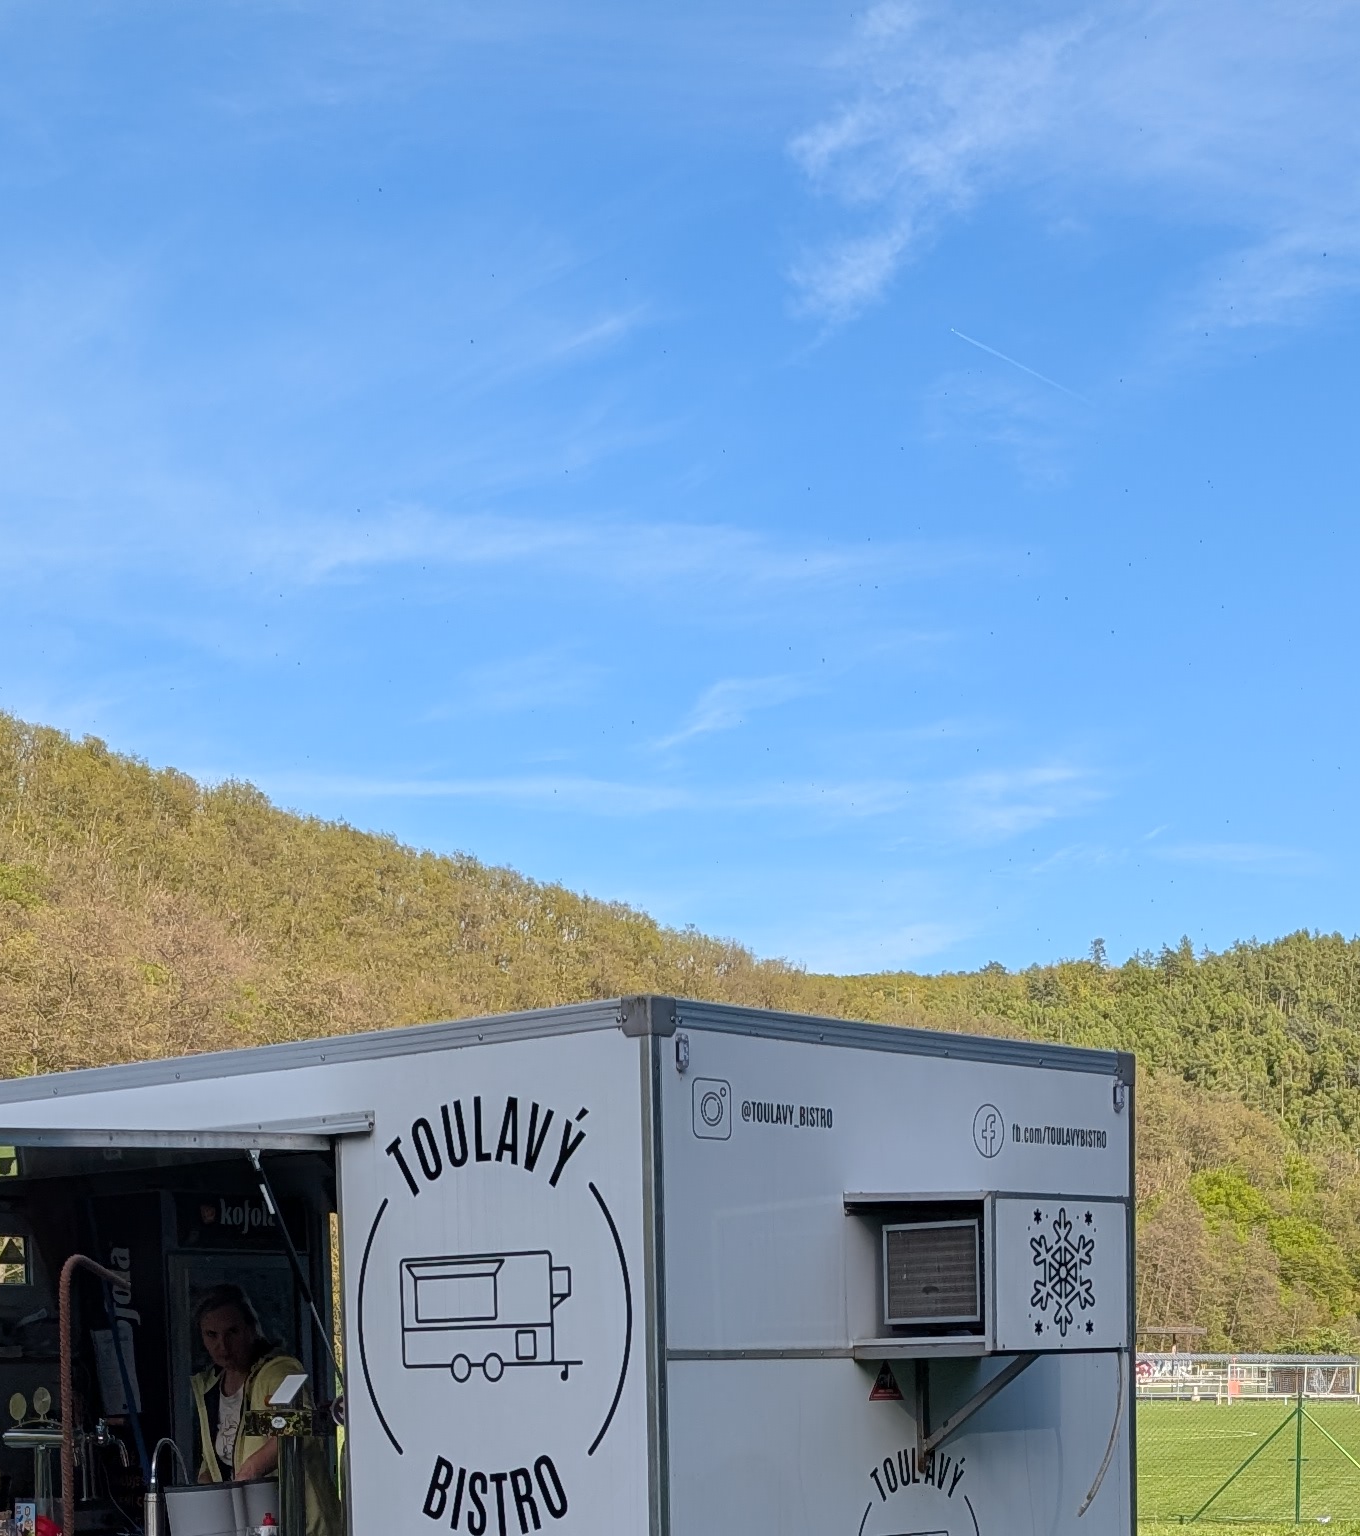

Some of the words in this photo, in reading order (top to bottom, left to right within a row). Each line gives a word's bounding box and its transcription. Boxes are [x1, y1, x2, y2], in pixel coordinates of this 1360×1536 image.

[741, 1099, 834, 1130] @TOULAVY_BISTRO
[385, 1095, 590, 1198] TOULAVÝ
[1012, 1124, 1108, 1150] fb.com/TOULAVYBISTRO
[870, 1446, 966, 1502] TOULAVÝ
